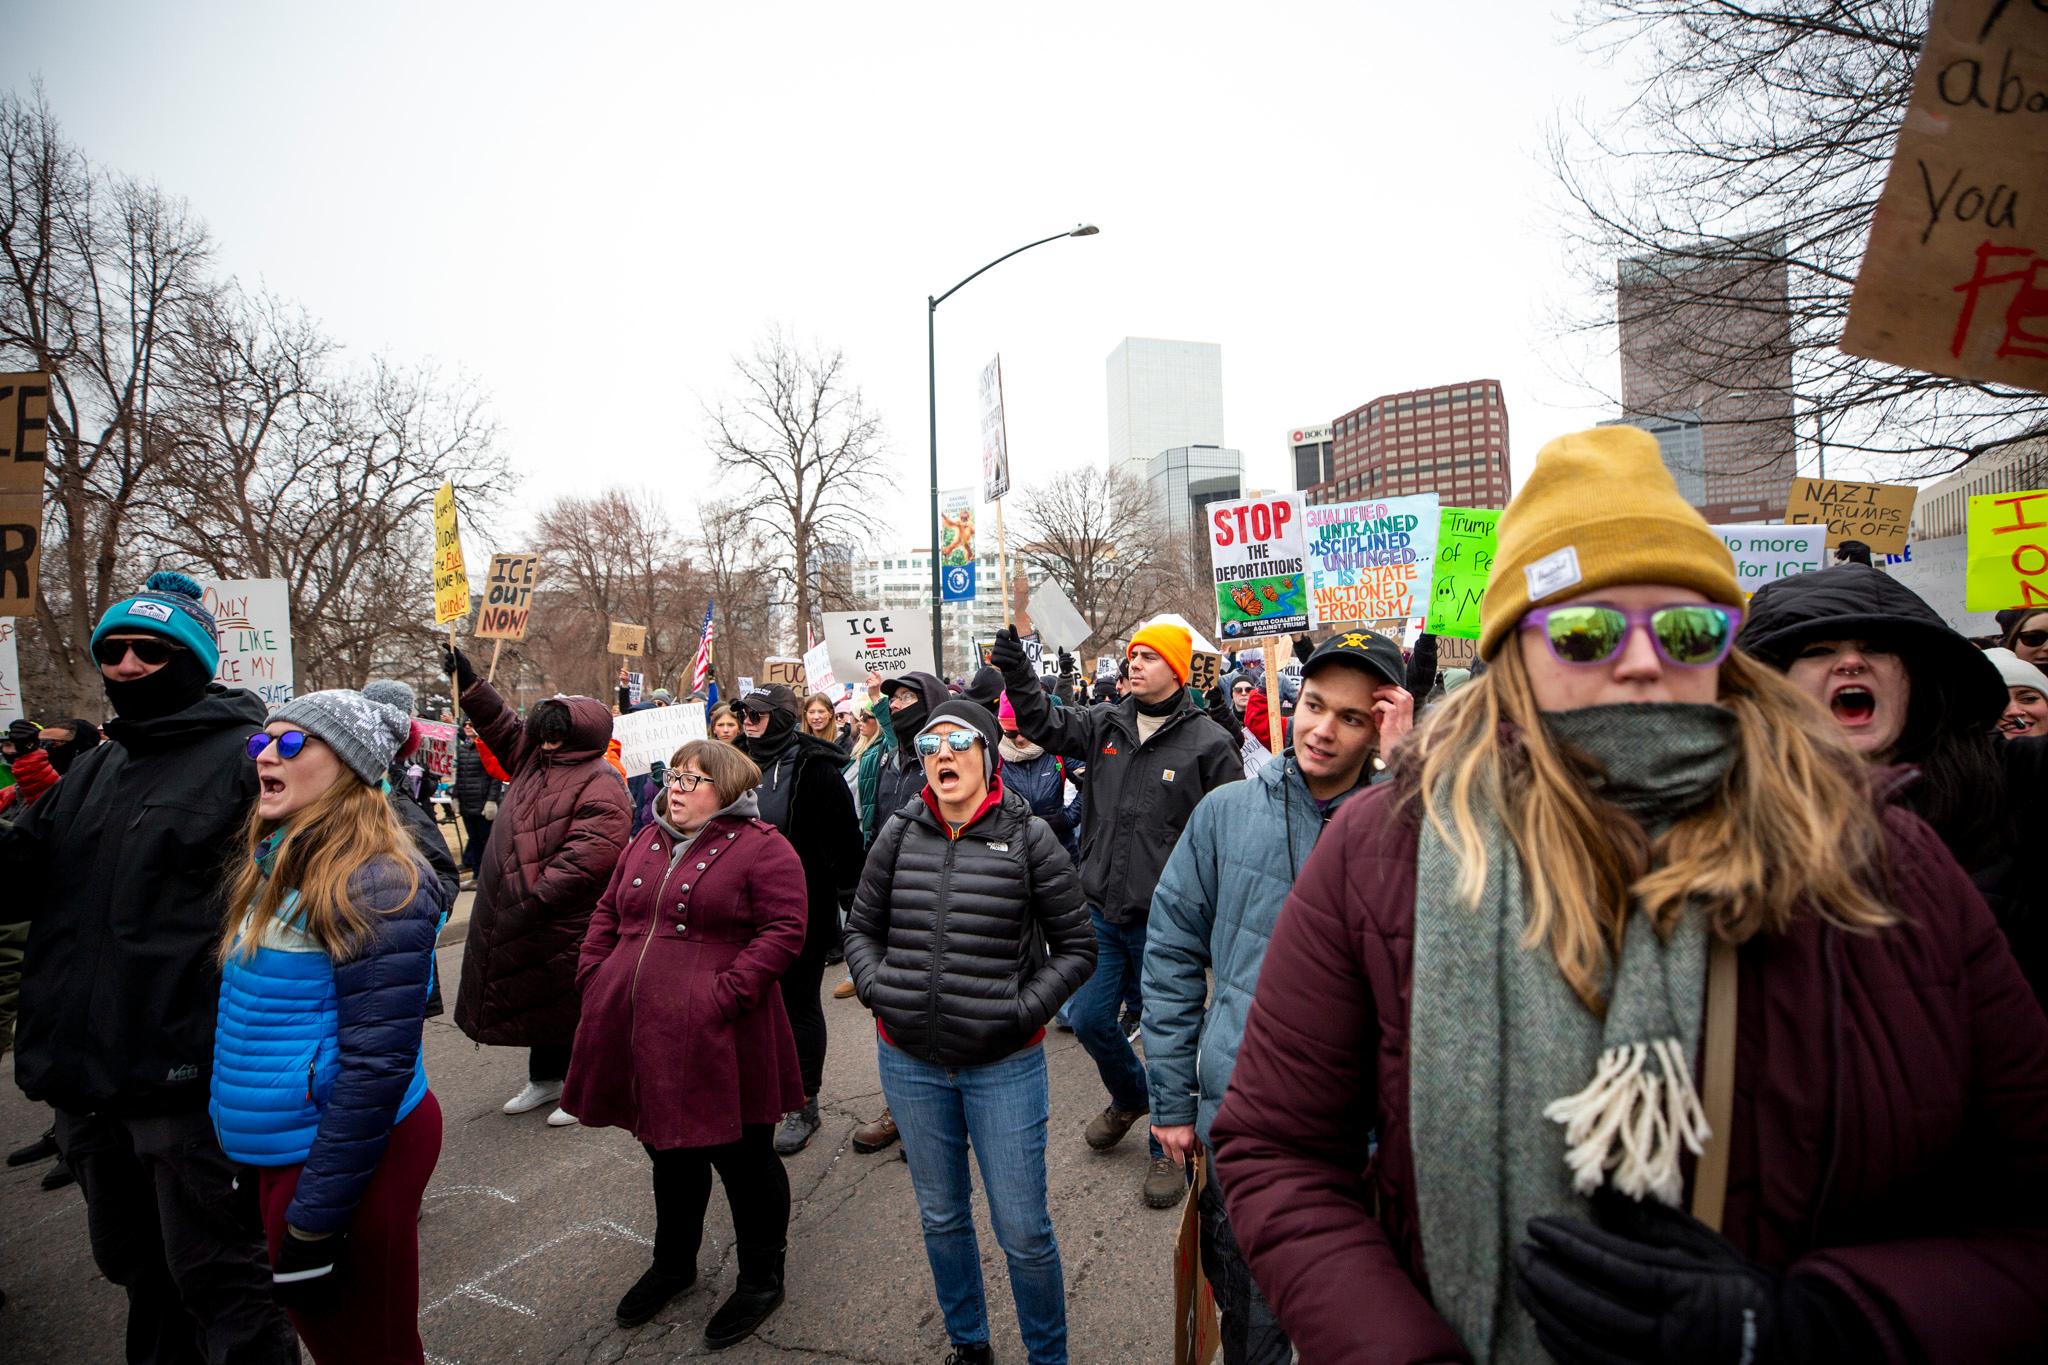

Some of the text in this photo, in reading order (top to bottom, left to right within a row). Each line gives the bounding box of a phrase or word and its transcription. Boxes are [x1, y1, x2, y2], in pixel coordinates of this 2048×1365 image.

[1305, 429, 1323, 439] BOK
[1805, 482, 1880, 505] NAZI
[1819, 502, 1904, 521] TRUMPS
[1214, 501, 1291, 547] STOP
[1320, 514, 1418, 541] UNTRAINED
[1448, 512, 1495, 536] Trump
[1860, 522, 1906, 537] OFF
[1247, 543, 1269, 560] THE
[1750, 538, 1808, 553] more
[1322, 547, 1430, 571] UNHINGED...
[1739, 560, 1767, 577] for
[492, 558, 537, 584] ICE
[1216, 558, 1303, 582] DEPORTATIONS
[1338, 568, 1355, 586] IS
[1360, 563, 1418, 584] STATE
[202, 587, 248, 617] ONLY
[489, 585, 531, 607] OUT
[1315, 595, 1414, 621] ERRORISM!
[482, 607, 529, 636] NOW!
[846, 616, 893, 636] ICE
[1243, 615, 1306, 628] DENVER COALITION
[1253, 624, 1281, 632] AGAINST
[239, 630, 278, 652] LIKE
[855, 647, 911, 660] AMERICAN
[1099, 659, 1109, 668] ICE
[252, 656, 275, 679] MY
[865, 660, 906, 672] GESTAPO
[629, 674, 641, 684] AIL
[1185, 673, 1214, 689] EX
[646, 724, 688, 743] RACISM
[416, 748, 454, 775] OURAGE
